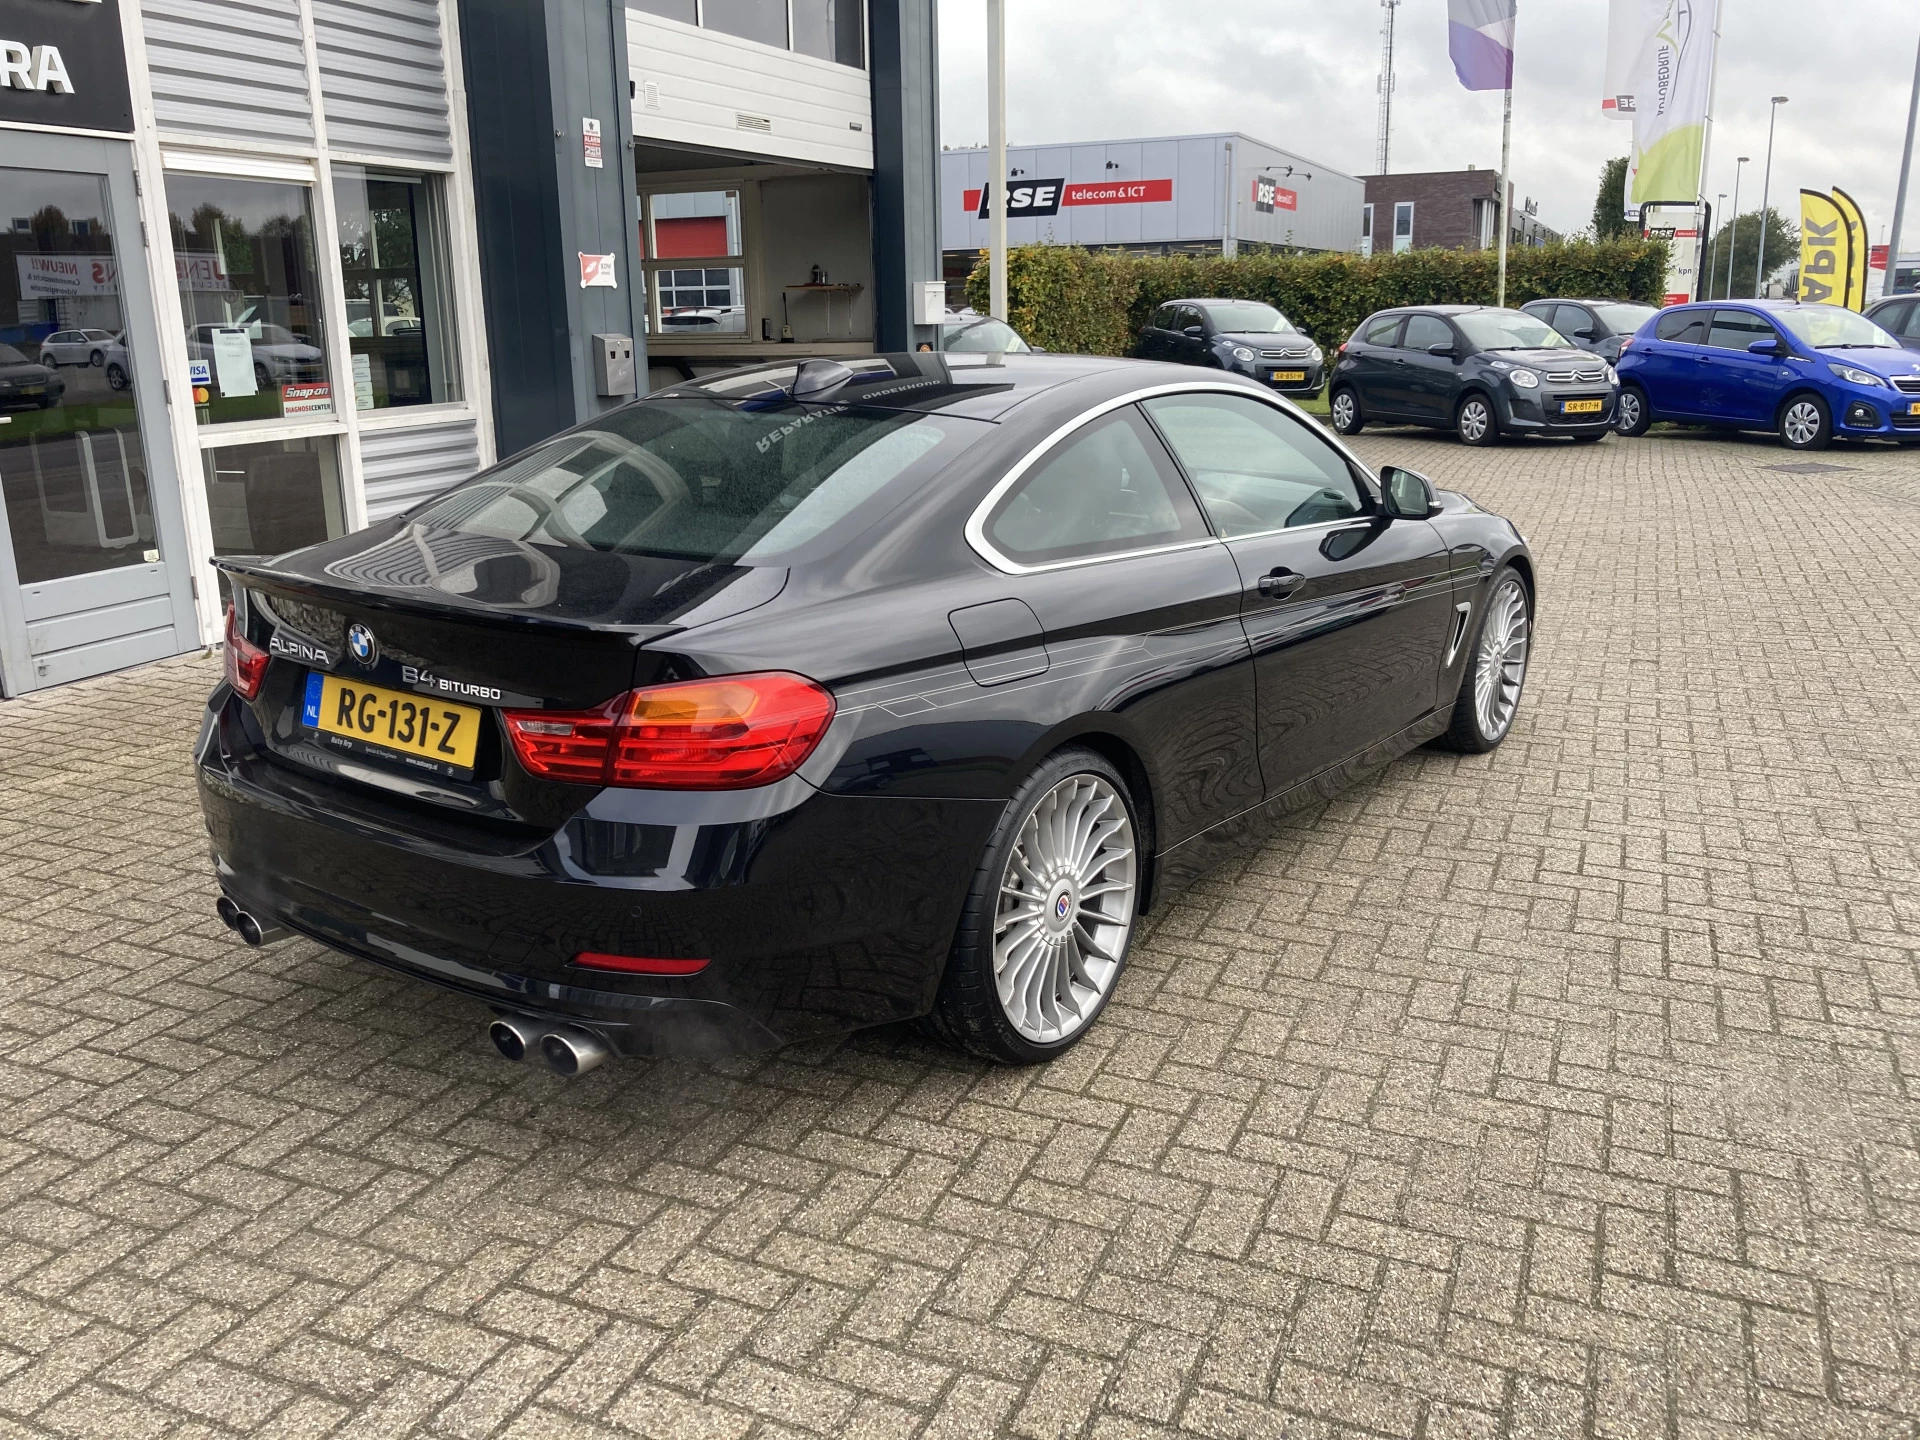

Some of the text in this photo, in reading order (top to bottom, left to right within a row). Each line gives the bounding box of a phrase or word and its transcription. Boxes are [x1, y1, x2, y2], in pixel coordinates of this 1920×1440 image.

[987, 186, 1146, 209] SE telecom & ICT
[1257, 182, 1275, 205] RSE
[1678, 267, 1692, 275] kpn
[285, 387, 329, 399] Snap-on
[285, 404, 331, 414] DIAGNOSECENTER
[1567, 402, 1599, 411] SR-817-H
[269, 637, 330, 665] ALPINA
[401, 665, 501, 700] B4 BITURBO
[306, 704, 318, 719] NL
[337, 687, 461, 755] RG-131-Z
